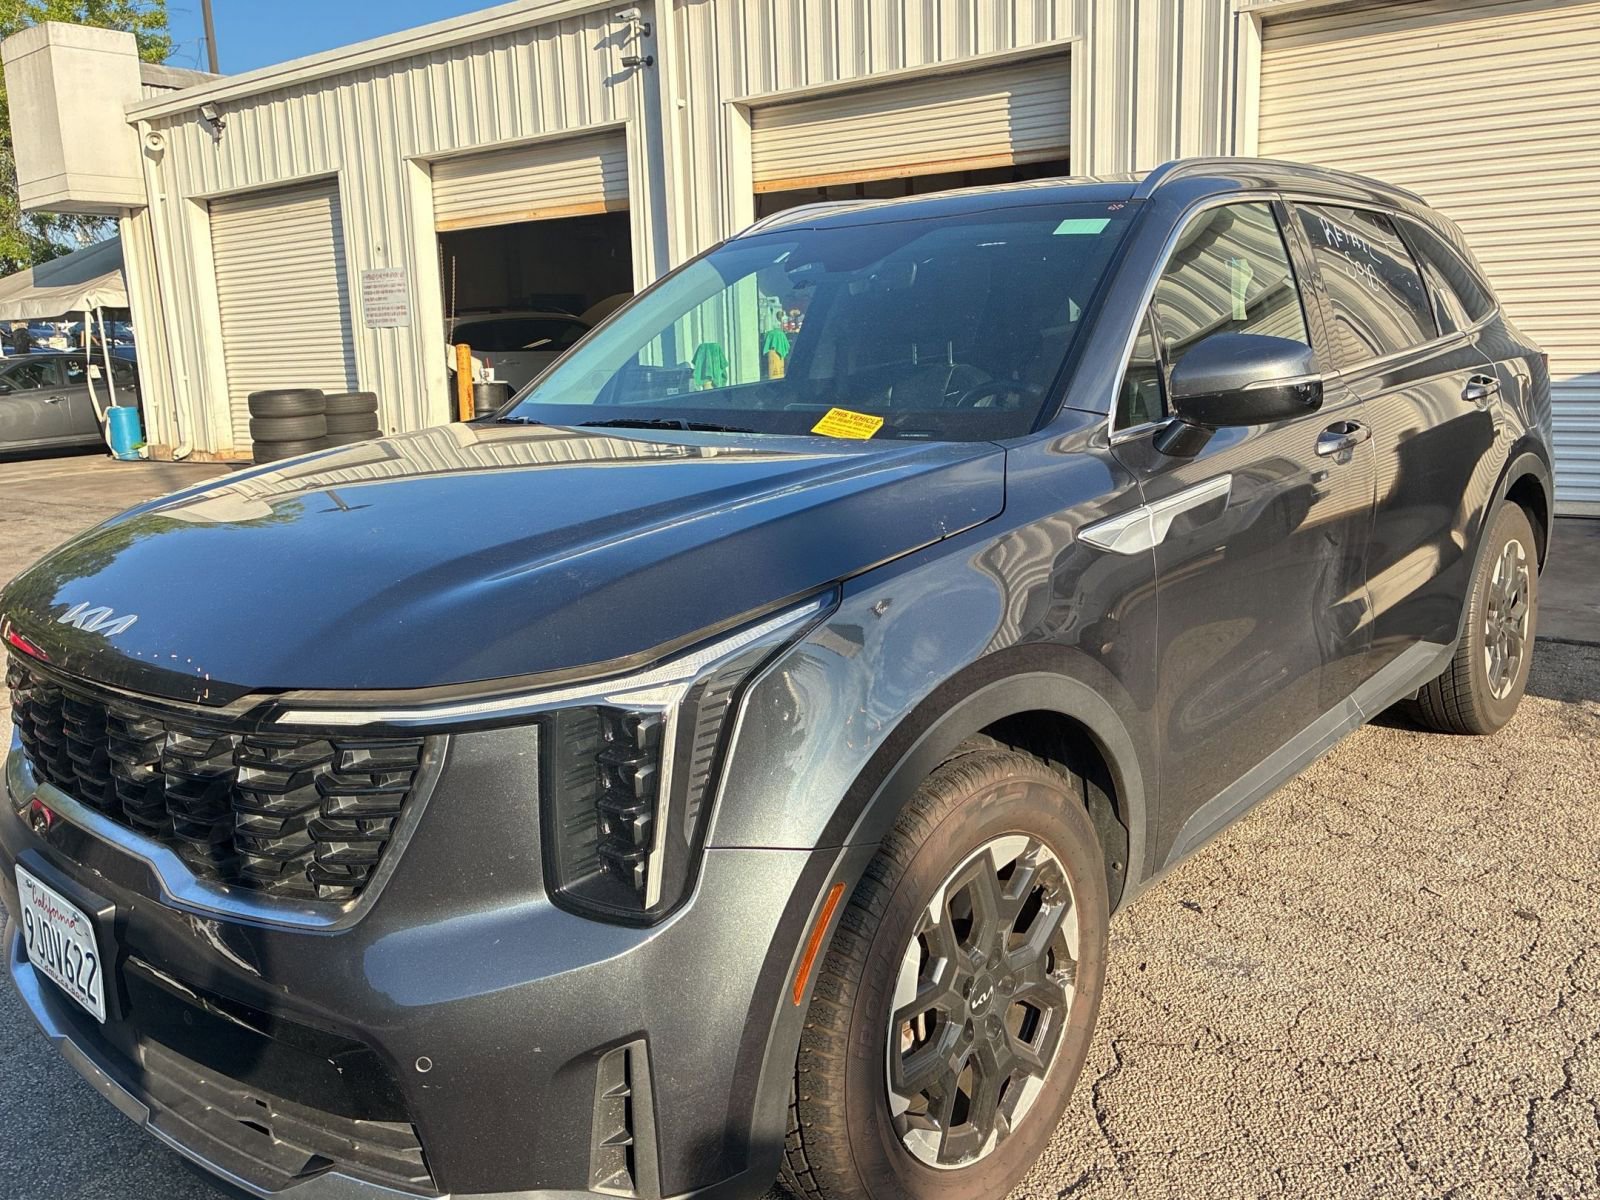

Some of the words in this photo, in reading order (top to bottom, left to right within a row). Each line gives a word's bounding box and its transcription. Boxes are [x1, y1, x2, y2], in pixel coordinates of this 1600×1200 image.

[849, 413, 880, 426] VEHICLE
[57, 601, 138, 637] KIA
[32, 884, 77, 929] California
